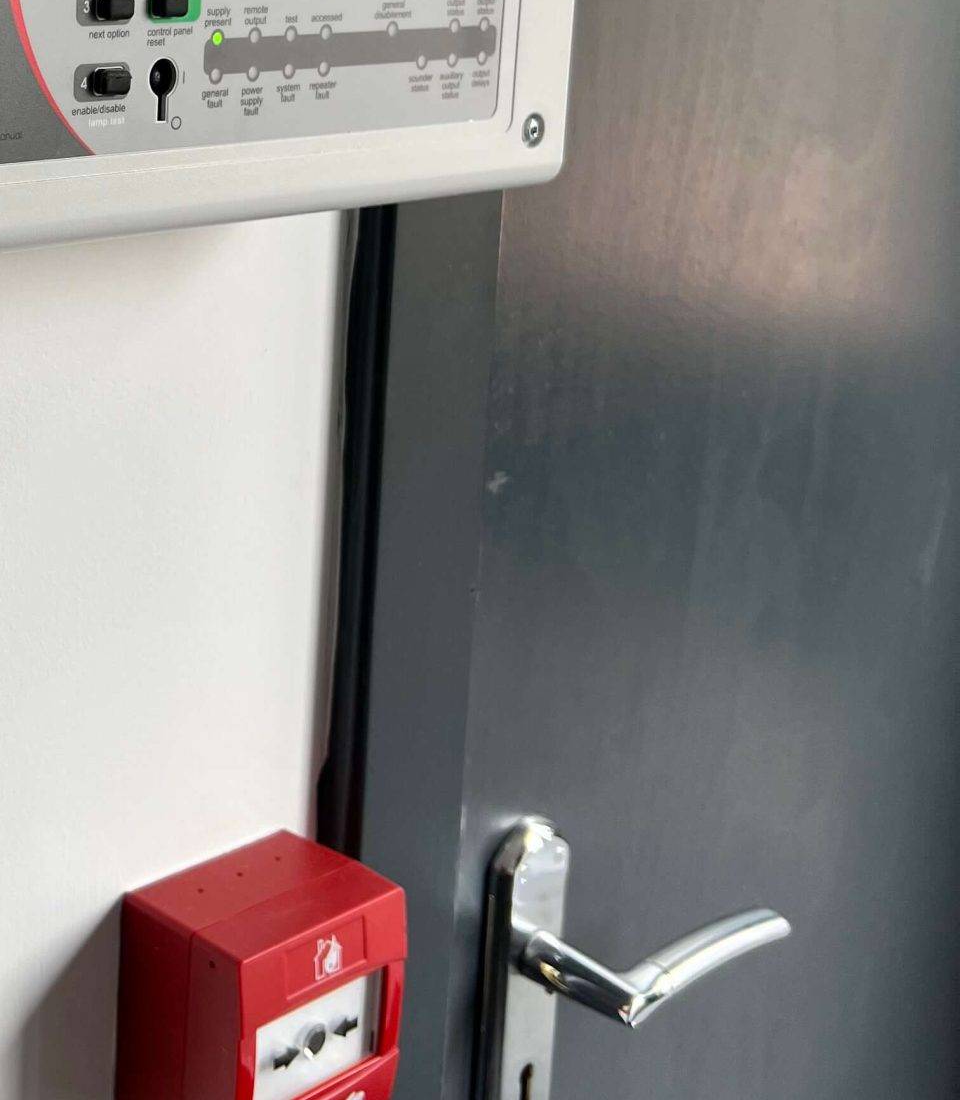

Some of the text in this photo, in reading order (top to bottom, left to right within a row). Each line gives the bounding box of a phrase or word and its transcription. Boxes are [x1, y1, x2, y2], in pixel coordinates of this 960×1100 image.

[83, 0, 90, 14] 3
[206, 6, 231, 17] supply
[204, 18, 232, 28] present
[285, 15, 298, 23] test
[88, 29, 130, 40] next option
[147, 26, 193, 37] control panel
[146, 38, 165, 47] reset
[80, 77, 88, 90] 4
[276, 83, 300, 93] system
[309, 81, 337, 91] repeater
[201, 88, 229, 100] general
[241, 86, 263, 97] power
[315, 90, 329, 100] fault
[240, 97, 263, 107] supply
[280, 93, 295, 103] fault
[207, 99, 223, 108] fault
[71, 104, 126, 117] enable/disable
[243, 107, 259, 116] fault
